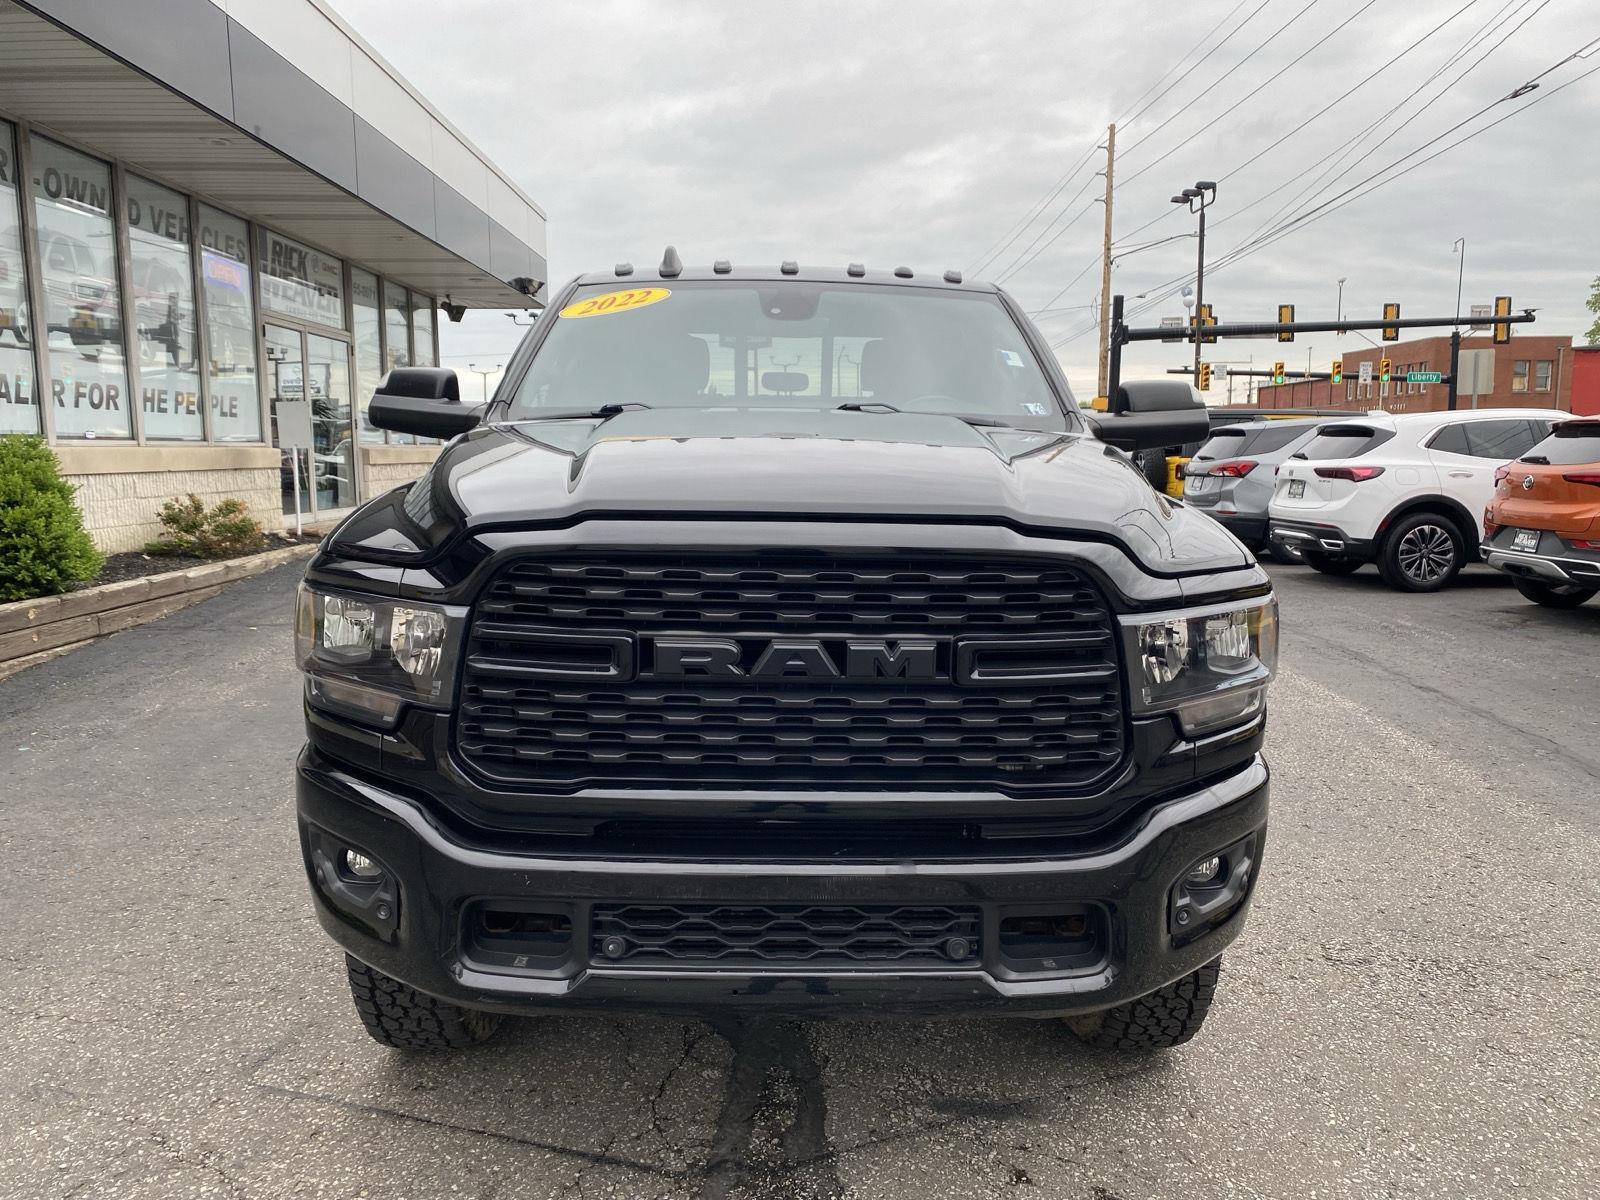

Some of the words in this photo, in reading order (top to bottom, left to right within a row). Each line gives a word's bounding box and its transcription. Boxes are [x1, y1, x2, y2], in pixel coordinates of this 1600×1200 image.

[149, 205, 246, 263] VEHCLES
[271, 239, 308, 282] RICK
[578, 290, 652, 316] 2022
[1411, 373, 1437, 381] Liberty
[74, 381, 120, 411] FOR
[142, 387, 168, 414] HE
[174, 390, 239, 418] PEPLE
[653, 637, 937, 679] RAM
